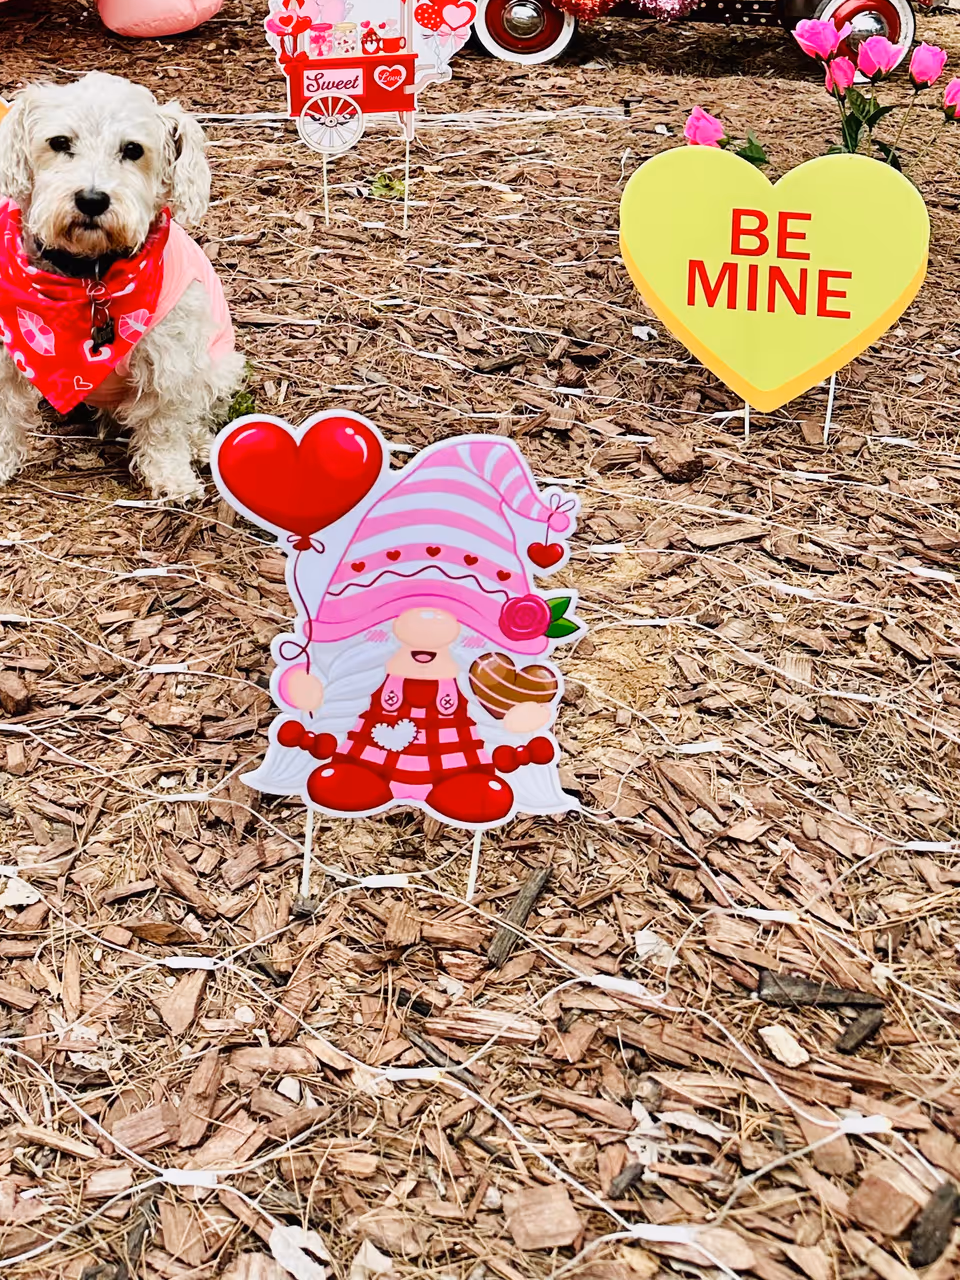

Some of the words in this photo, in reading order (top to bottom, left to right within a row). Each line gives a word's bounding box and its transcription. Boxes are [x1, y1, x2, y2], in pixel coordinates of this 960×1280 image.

[305, 72, 359, 93] Sweet
[730, 208, 812, 261] BE
[686, 259, 853, 319] MINE
